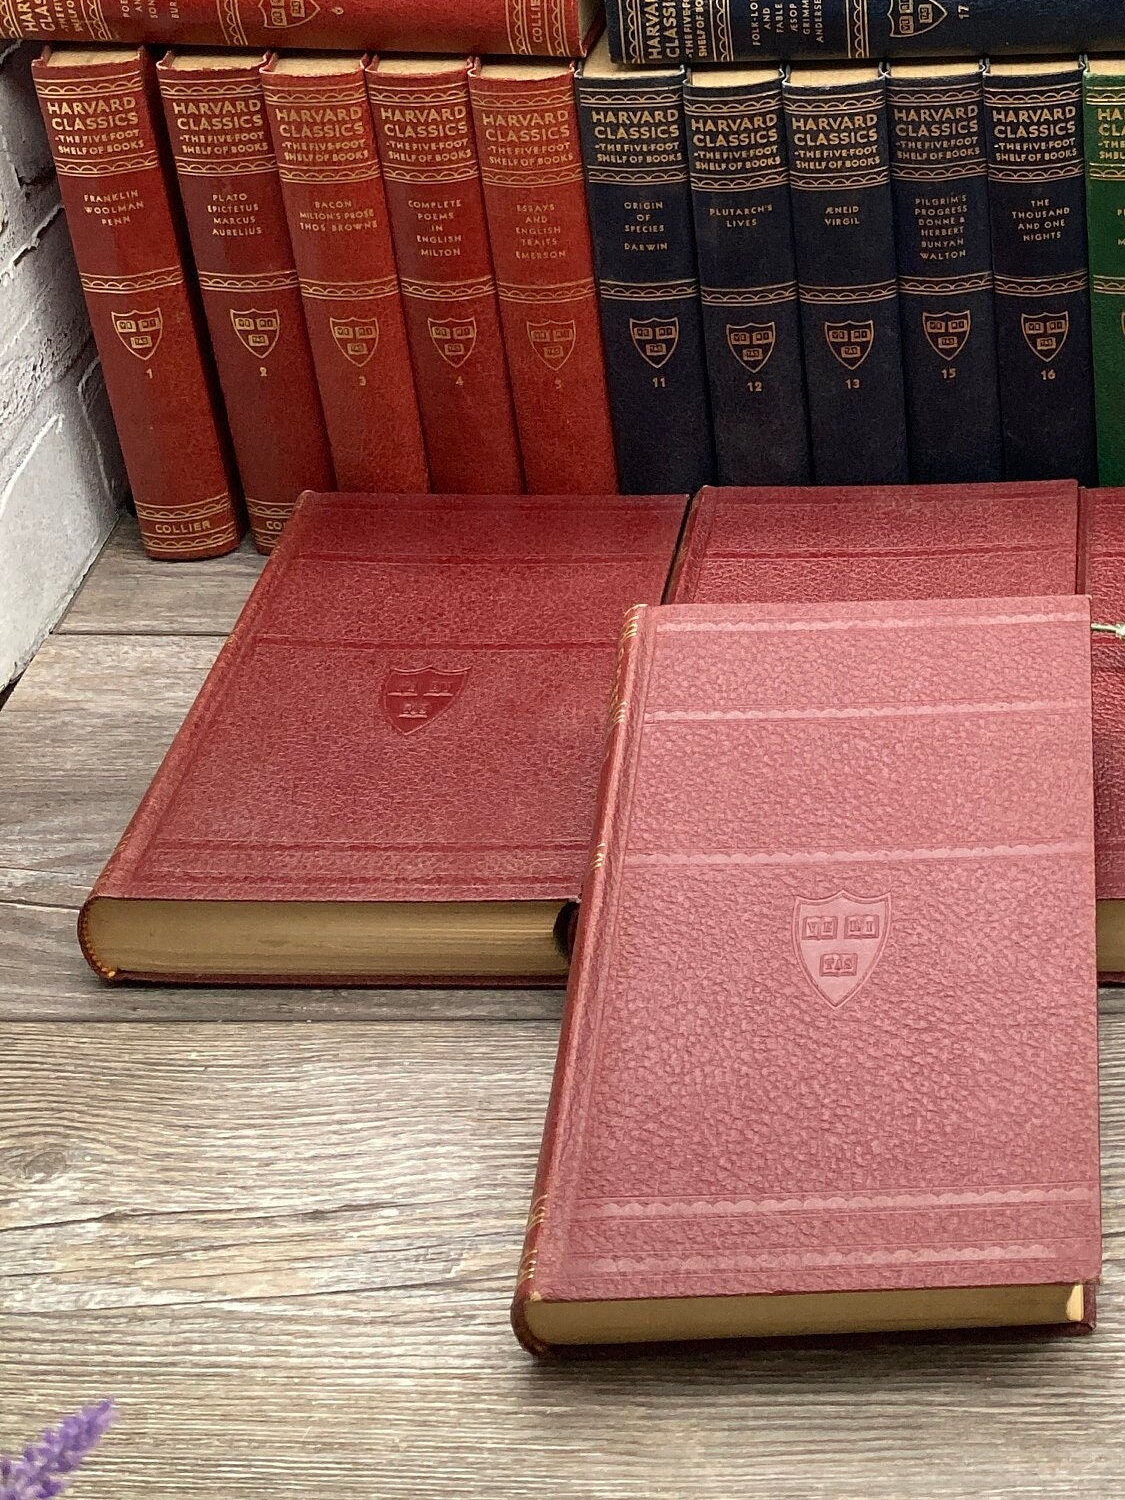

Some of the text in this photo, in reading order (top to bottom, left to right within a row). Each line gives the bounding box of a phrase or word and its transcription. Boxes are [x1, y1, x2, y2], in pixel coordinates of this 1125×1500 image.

[775, 3, 784, 33] FABLE
[802, 0, 810, 33] GRIMM
[47, 97, 136, 115] HARVARD
[172, 99, 261, 115] HARVARD
[894, 106, 978, 121] HARVARD
[51, 113, 138, 131] CLASSICS
[276, 108, 362, 123] HARVARD
[380, 106, 466, 123] HARVARD
[482, 110, 568, 127] HARVARD
[591, 110, 678, 123] HARVARD
[792, 114, 878, 129] HARVARD
[992, 106, 1076, 123] HARVARD
[176, 115, 263, 130] CLASSICS
[280, 122, 365, 138] CLASSICS
[691, 114, 778, 131] HARVARD
[895, 121, 978, 137] CLASSICS
[994, 121, 1076, 138] CLASSICS
[384, 123, 468, 138] CLASSICS
[486, 126, 570, 142] CLASSICS
[594, 125, 680, 139] CLASSICS
[794, 129, 878, 146] CLASSICS
[692, 131, 778, 147] CLASSICS
[630, 154, 644, 162] OF
[624, 201, 663, 210] ORIGIN
[1012, 207, 1070, 219] THOUSAND
[213, 216, 256, 225] MARCUS
[636, 214, 650, 222] OF
[726, 219, 757, 228] LIVES
[825, 218, 860, 226] VIRGIL
[1018, 219, 1065, 229] AND ONE
[211, 226, 263, 236] AURELIUS
[1023, 231, 1061, 241] NIGHTS
[421, 248, 461, 257] MILTON
[920, 250, 966, 260] WALTON
[942, 369, 956, 379] 15
[1041, 370, 1056, 380] 16
[652, 378, 666, 388] 11
[846, 379, 860, 389] 13
[155, 520, 211, 534] COLLIER
